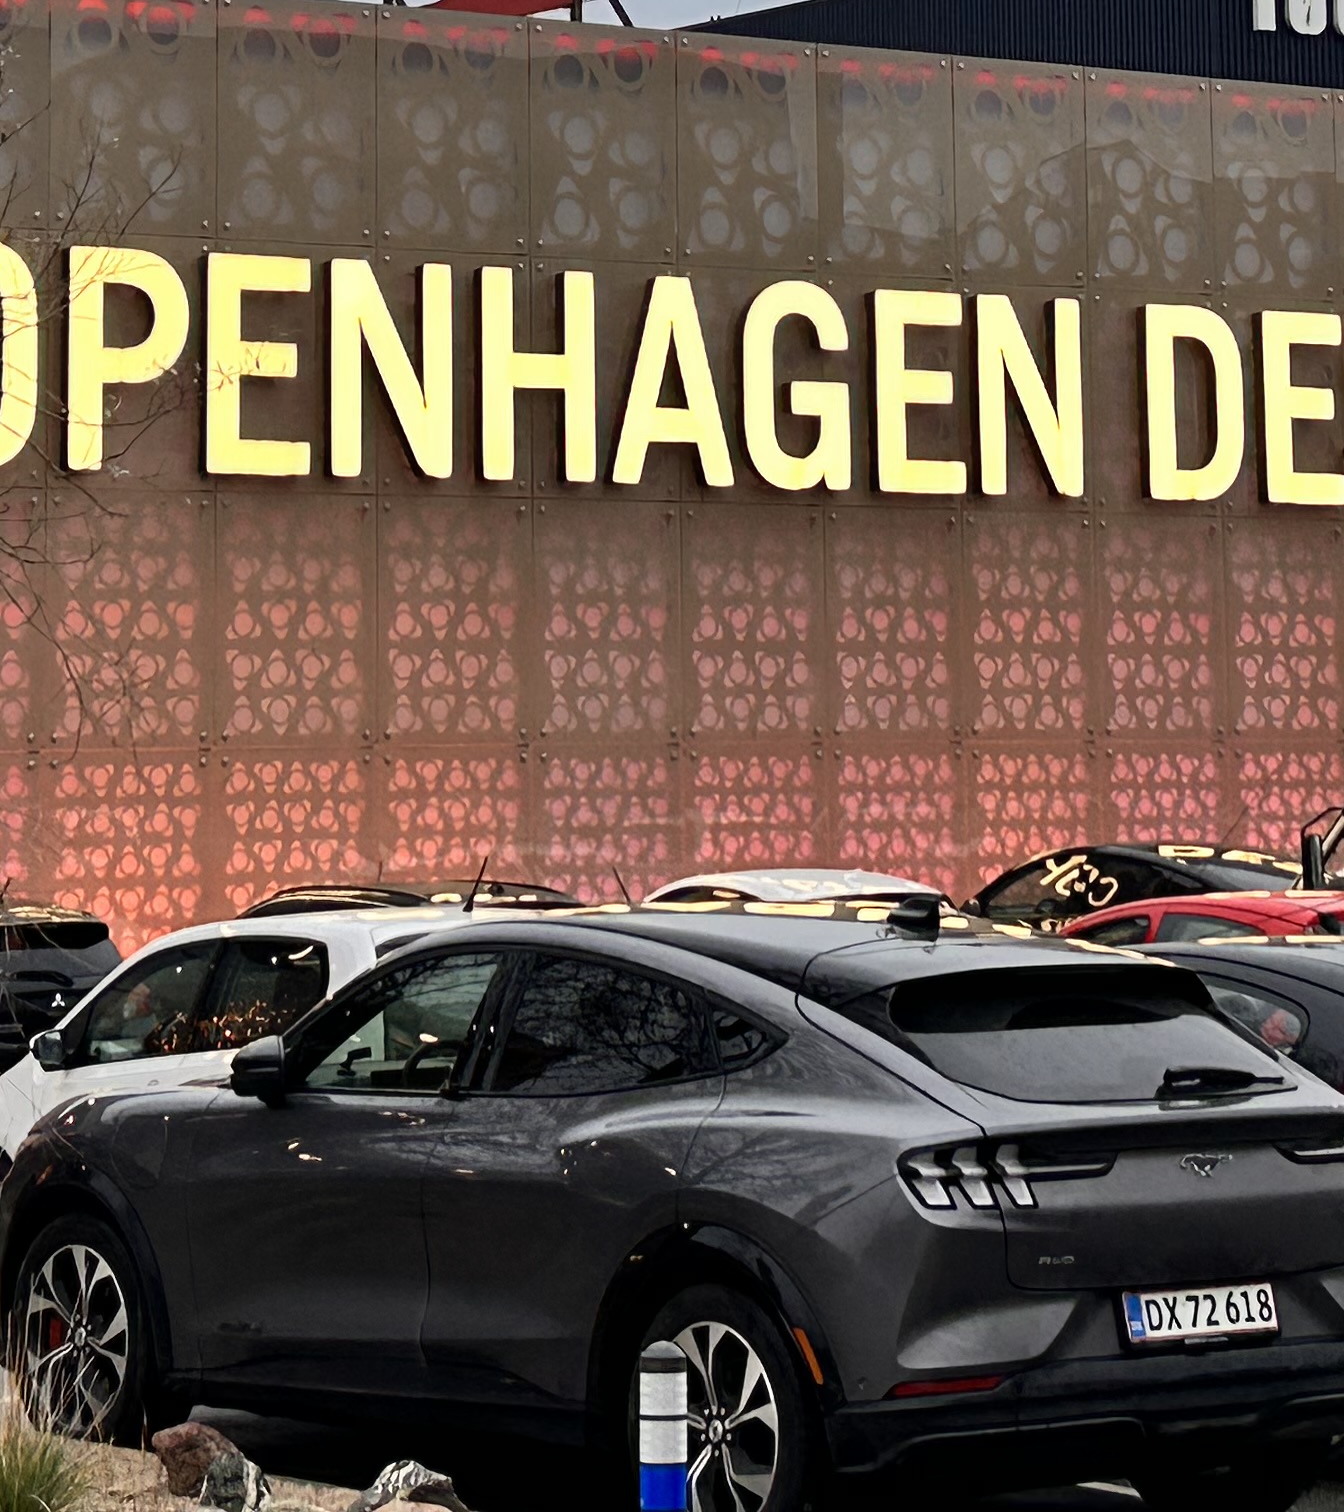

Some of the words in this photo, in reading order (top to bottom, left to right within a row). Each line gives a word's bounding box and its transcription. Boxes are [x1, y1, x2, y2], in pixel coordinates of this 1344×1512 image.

[1144, 1296, 1182, 1332] DX
[1185, 1293, 1221, 1329] 72
[1225, 1288, 1274, 1325] 618
